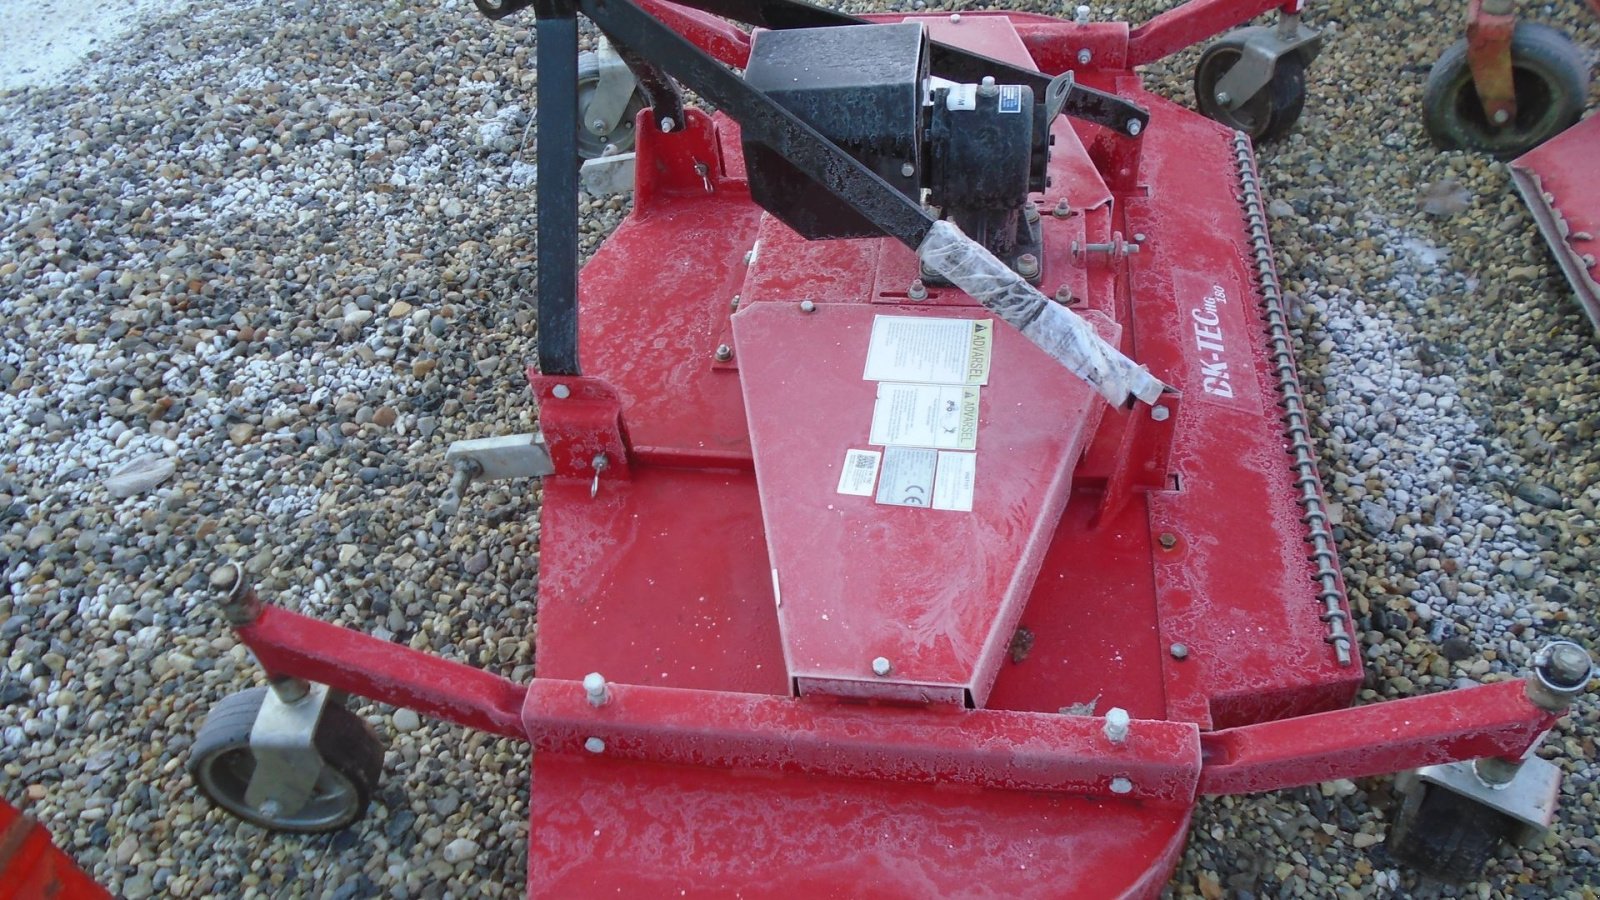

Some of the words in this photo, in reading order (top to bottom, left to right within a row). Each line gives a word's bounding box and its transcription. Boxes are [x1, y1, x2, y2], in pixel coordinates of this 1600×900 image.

[1213, 285, 1227, 304] 180
[968, 335, 985, 381] ADVARSEL
[1192, 308, 1233, 398] DK-TEC
[961, 401, 975, 444] ADVARSEL
